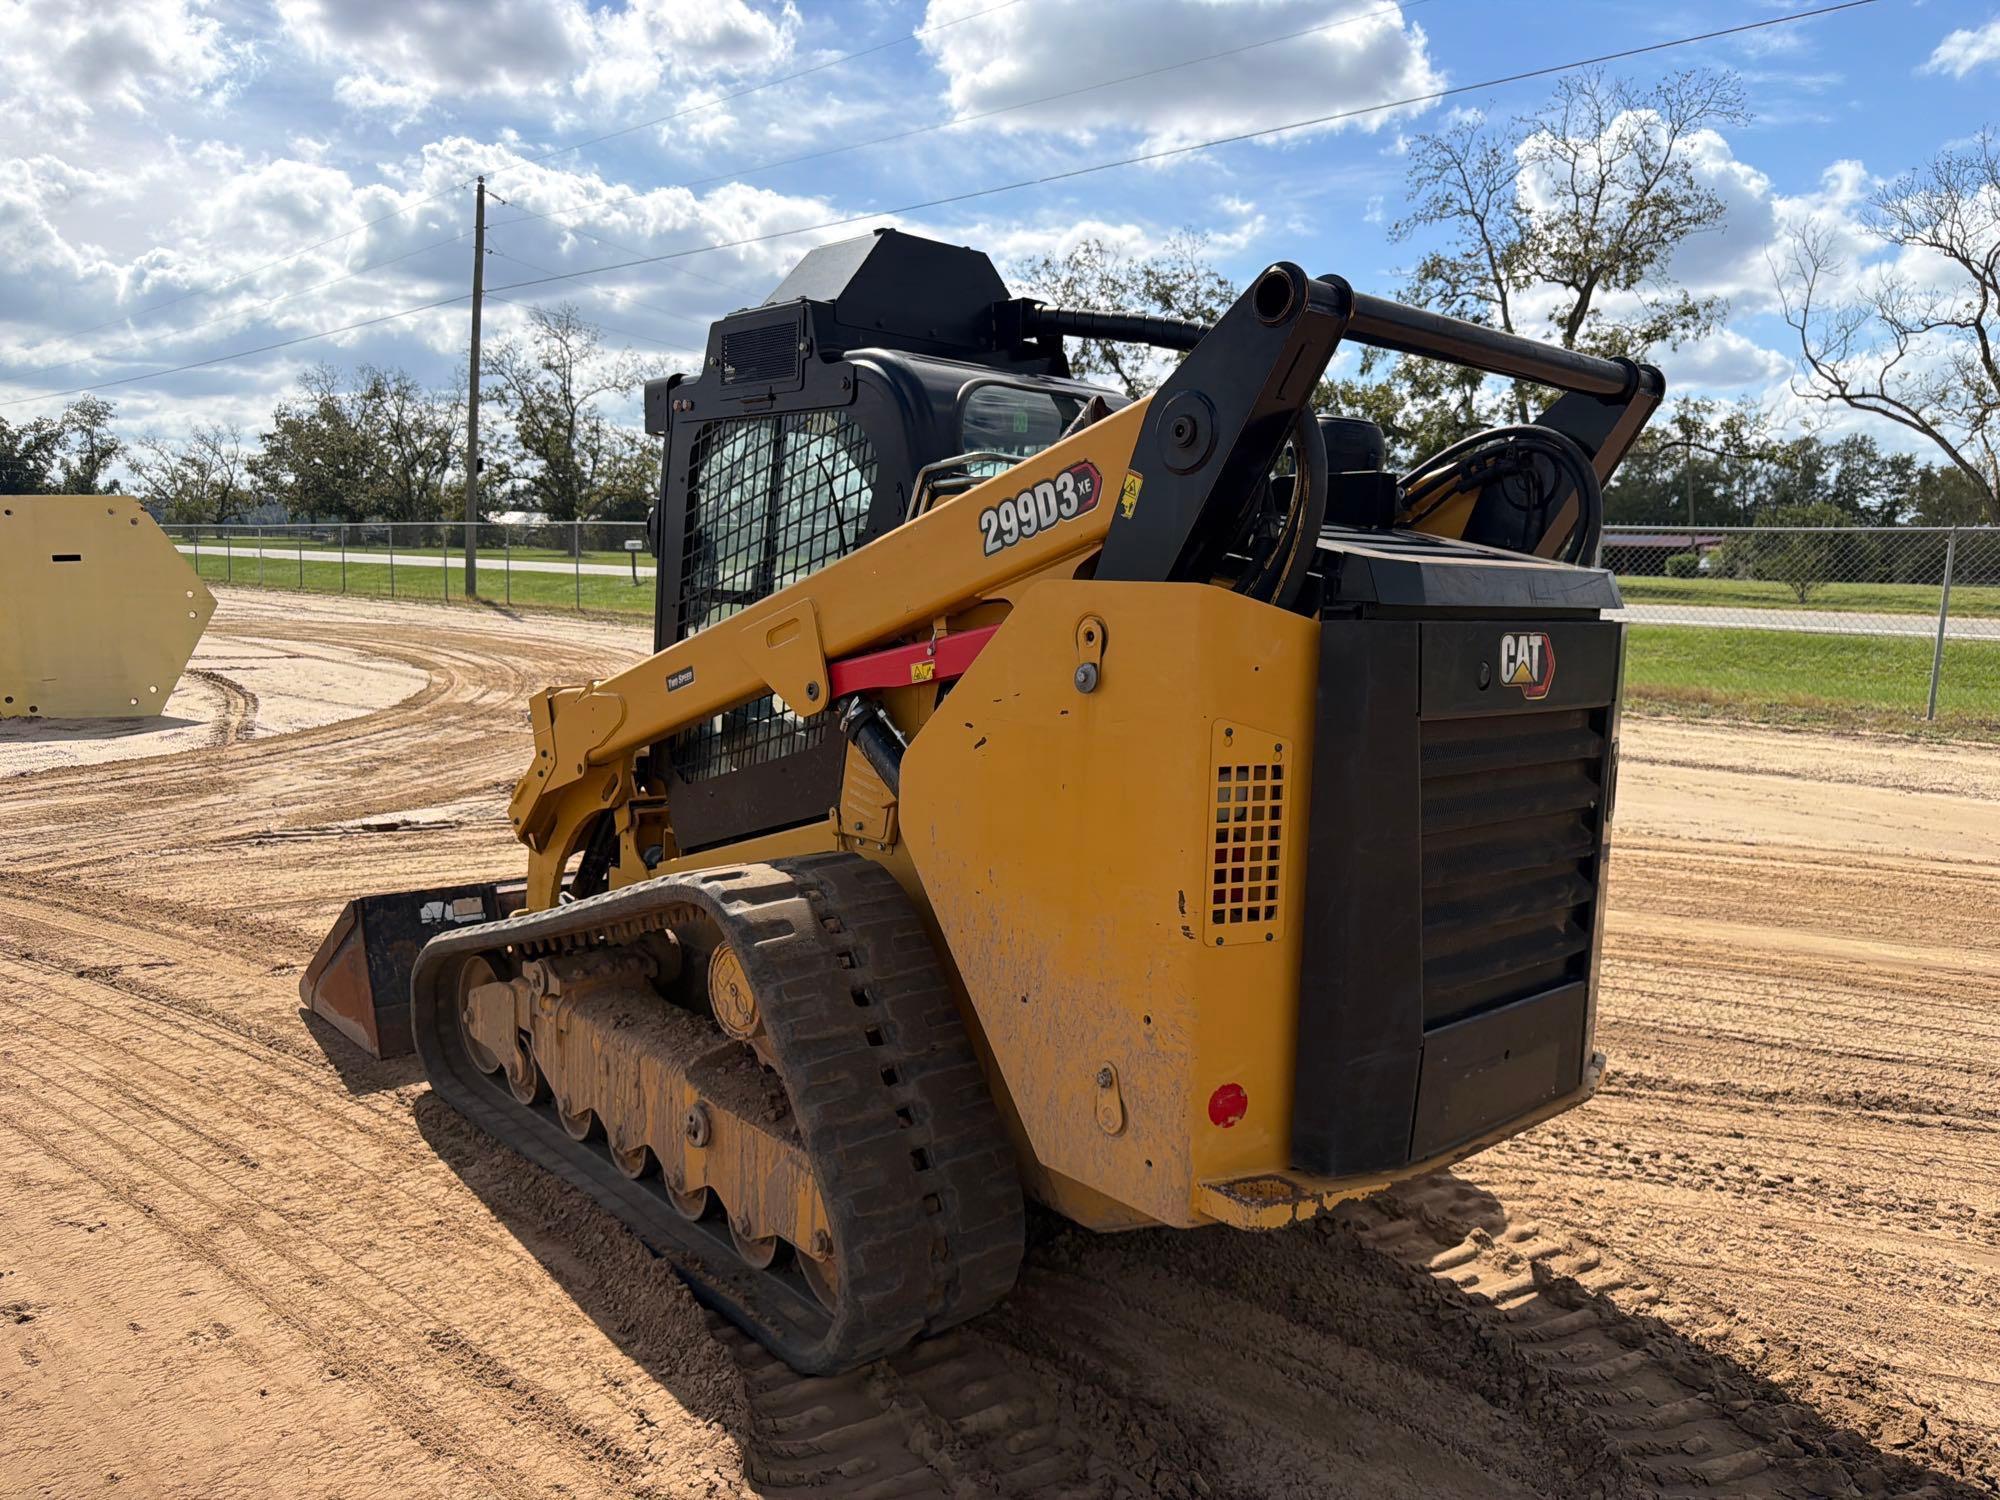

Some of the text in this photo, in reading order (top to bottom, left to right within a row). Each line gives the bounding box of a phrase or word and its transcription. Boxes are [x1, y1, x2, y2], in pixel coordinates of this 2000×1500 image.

[981, 472, 1092, 554] 299D3 XE
[1501, 634, 1543, 683] CAT
